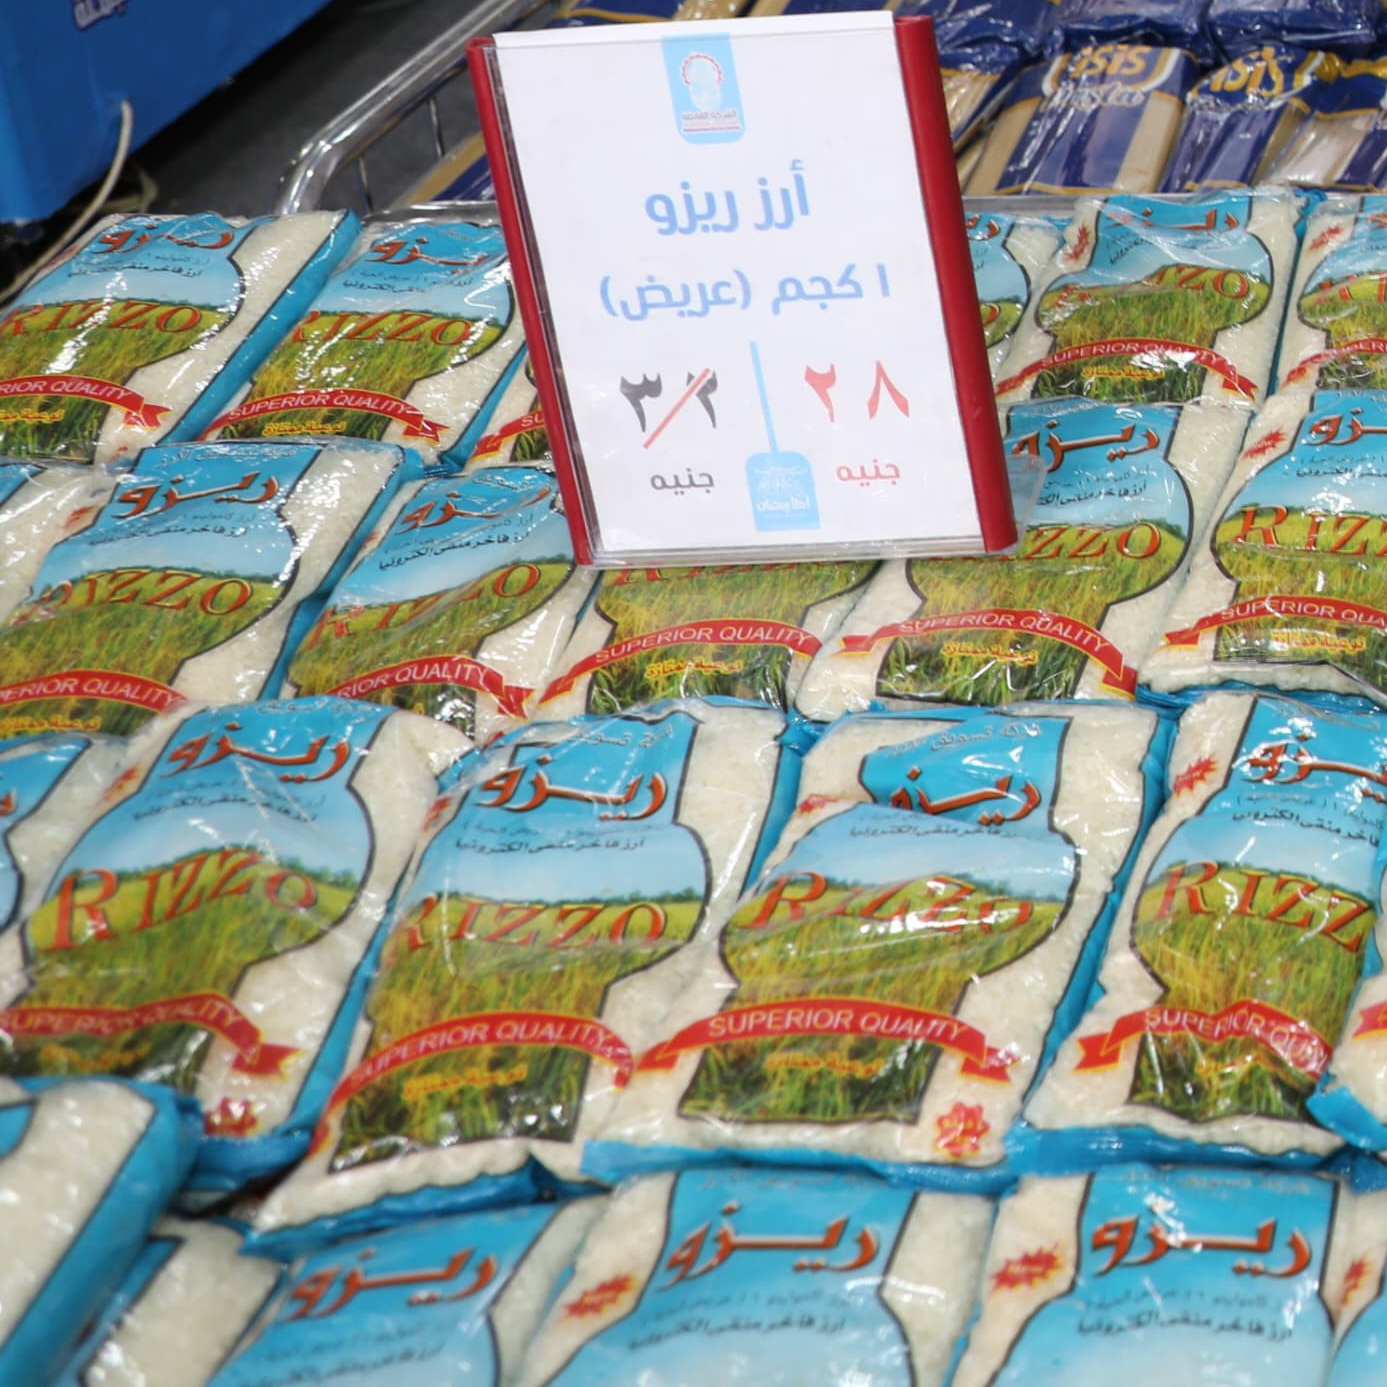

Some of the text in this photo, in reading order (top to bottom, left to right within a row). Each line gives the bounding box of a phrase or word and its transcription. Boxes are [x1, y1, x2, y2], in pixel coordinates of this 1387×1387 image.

[644, 158, 811, 236] أرز ريزو
[601, 269, 752, 322] (عريض)
[771, 264, 863, 315] كجم
[49, 379, 130, 400] QUALITY
[228, 393, 329, 422] SUPERIOR
[112, 472, 280, 519] ريزو
[650, 461, 901, 491] جنيه جنيه
[1221, 598, 1335, 621] SUPERIOR
[594, 622, 811, 664] SUPERIOR QUALITY
[899, 612, 1108, 653] SUPERIOR QUALITY
[82, 677, 186, 703] QUALITY
[393, 662, 492, 687] QUALITY
[161, 721, 352, 784] ريزو
[474, 754, 668, 820] ريزو
[39, 846, 317, 952] RIZZO
[707, 1008, 968, 1044] SUPERIOR QUALITY
[1144, 1010, 1268, 1045] SUPERIOR
[656, 1199, 880, 1294] ريزو
